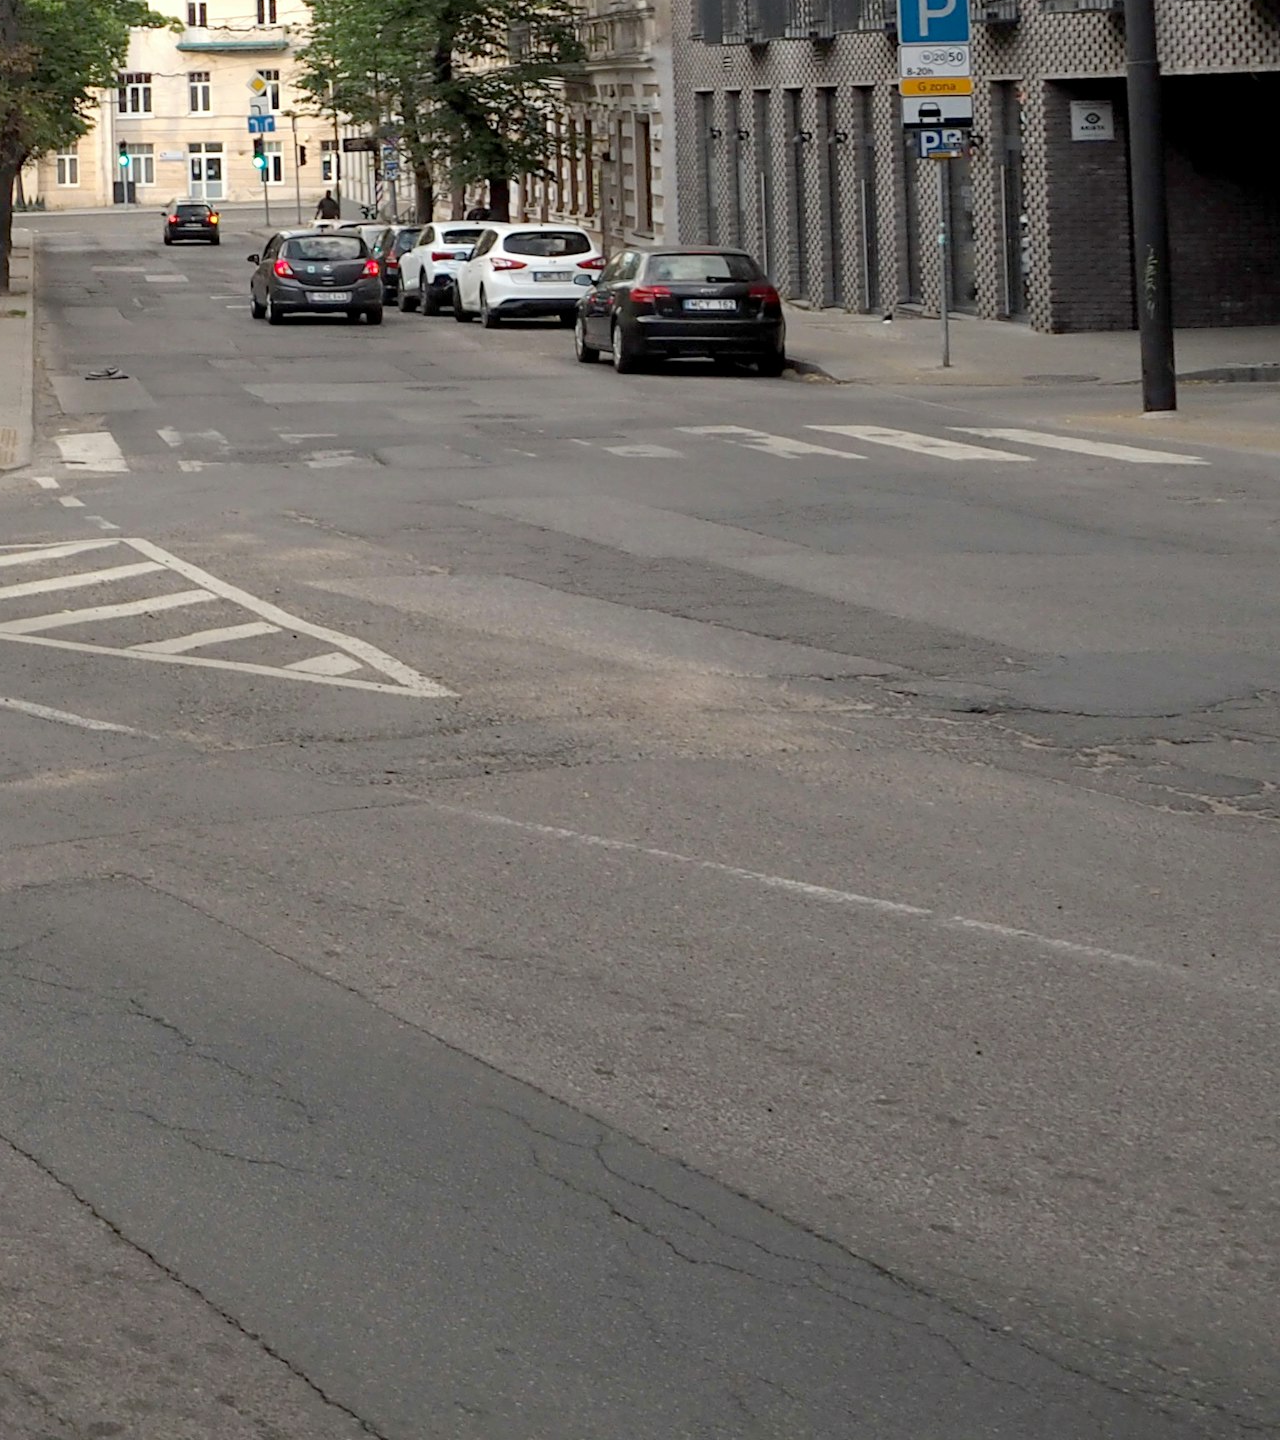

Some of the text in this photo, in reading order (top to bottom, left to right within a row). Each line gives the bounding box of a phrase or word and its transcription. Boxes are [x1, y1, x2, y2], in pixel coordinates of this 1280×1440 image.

[934, 53, 945, 61] 20
[948, 52, 964, 62] 50
[906, 67, 934, 75] 8-20h
[930, 83, 956, 91] zona
[920, 131, 940, 157] P
